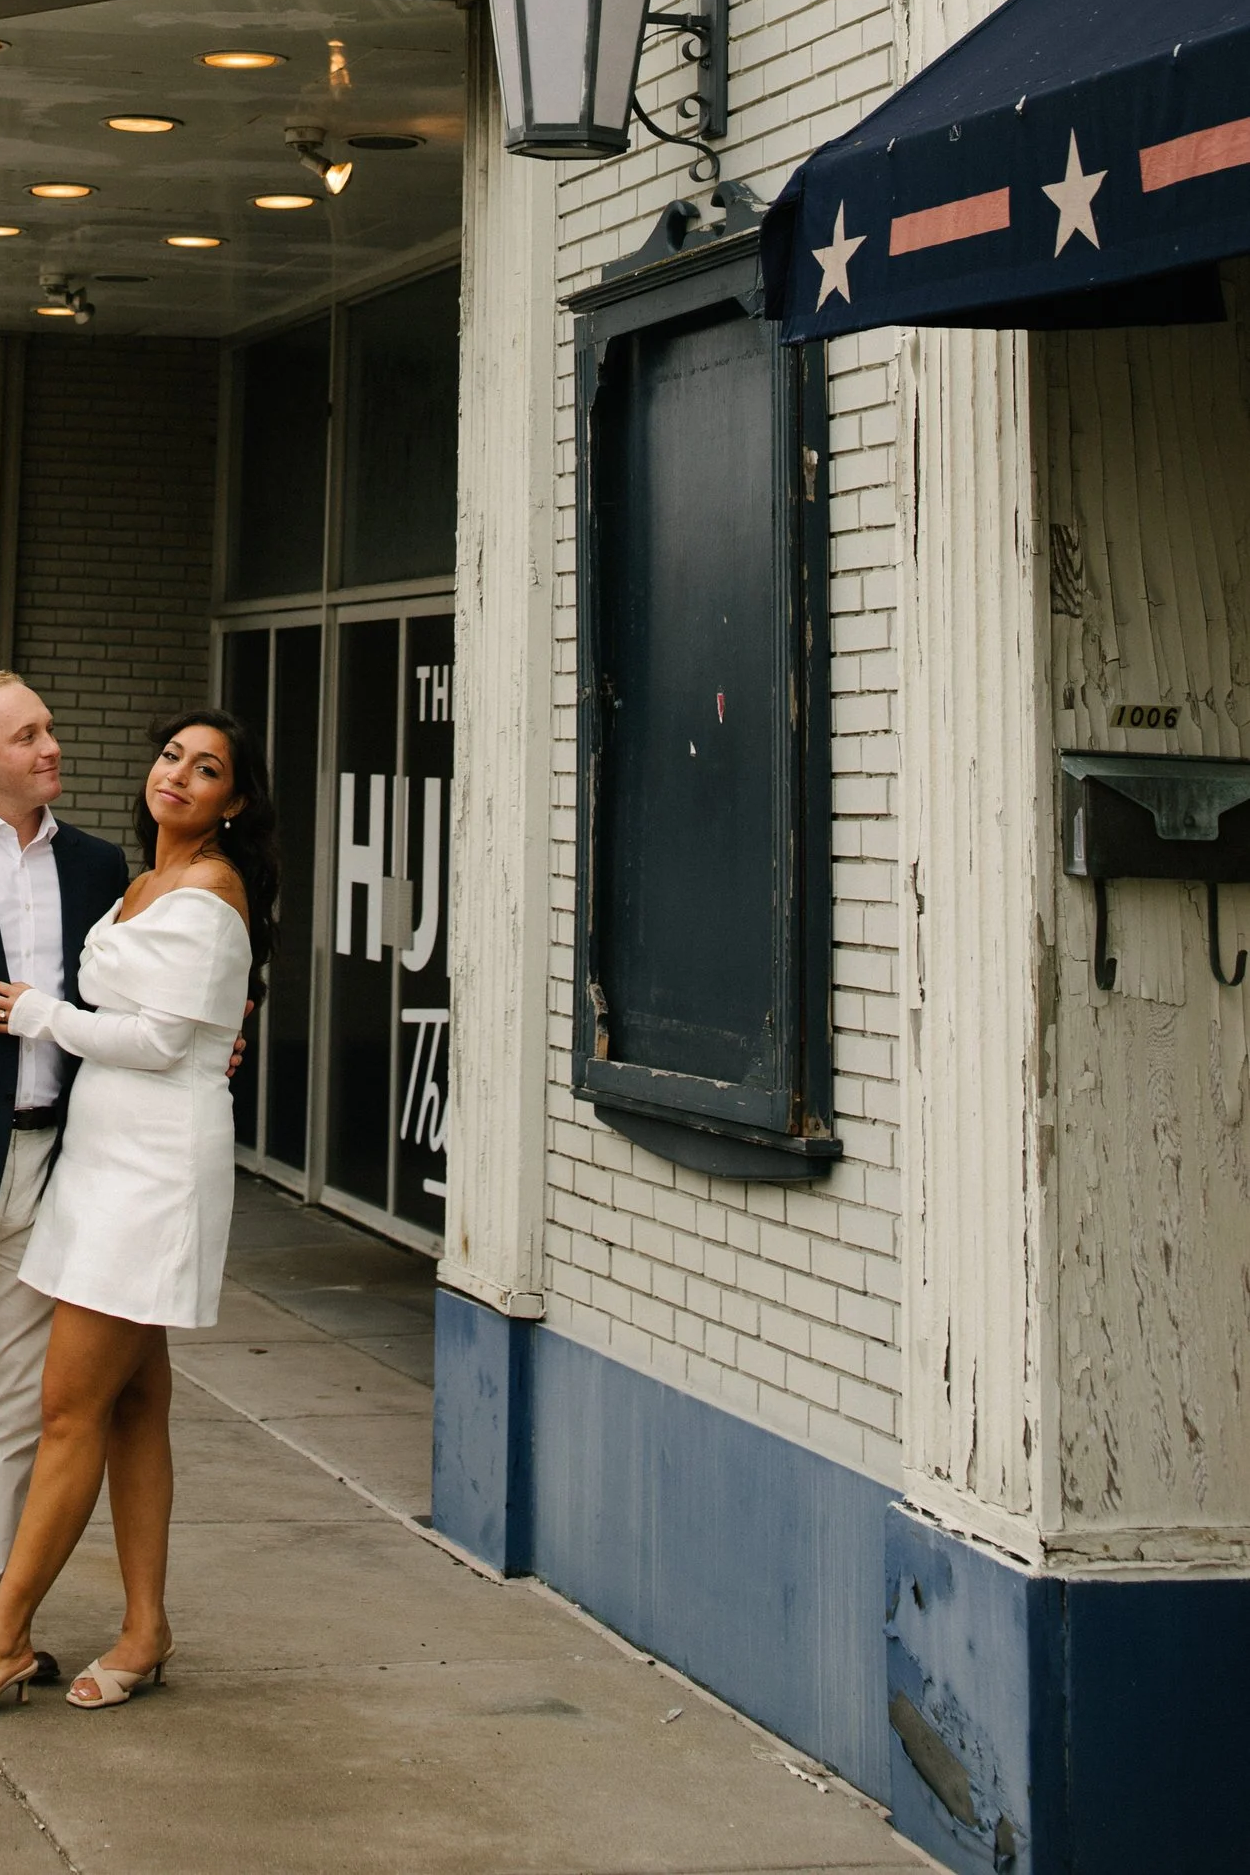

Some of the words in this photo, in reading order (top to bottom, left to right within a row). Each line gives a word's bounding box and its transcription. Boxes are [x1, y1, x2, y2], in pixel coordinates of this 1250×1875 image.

[416, 664, 455, 721] TH
[1117, 706, 1178, 728] 1006
[336, 772, 453, 978] HU
